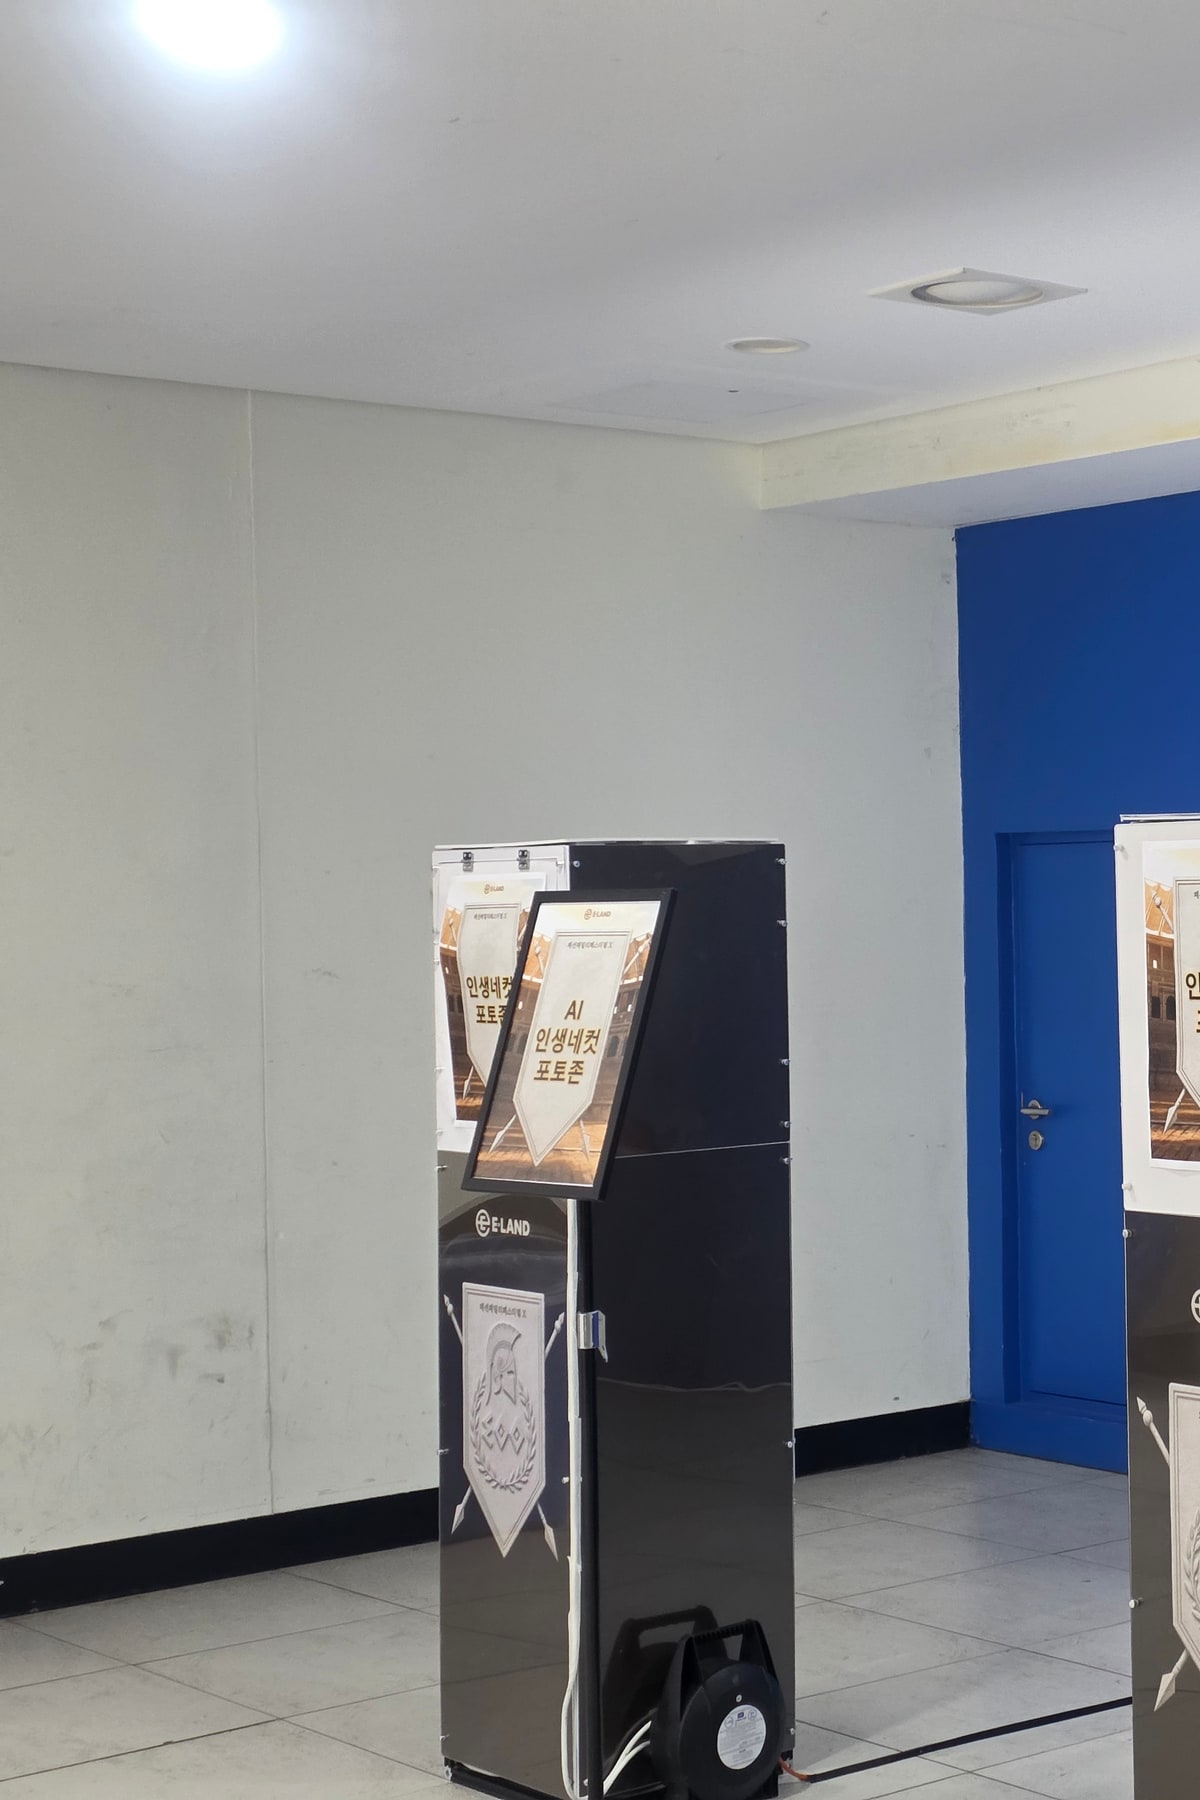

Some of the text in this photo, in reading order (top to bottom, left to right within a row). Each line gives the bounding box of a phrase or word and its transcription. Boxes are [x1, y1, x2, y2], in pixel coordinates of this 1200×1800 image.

[563, 1000, 584, 1021] AI
[535, 1027, 601, 1055] 인생네컷
[533, 1060, 585, 1085] 포토존
